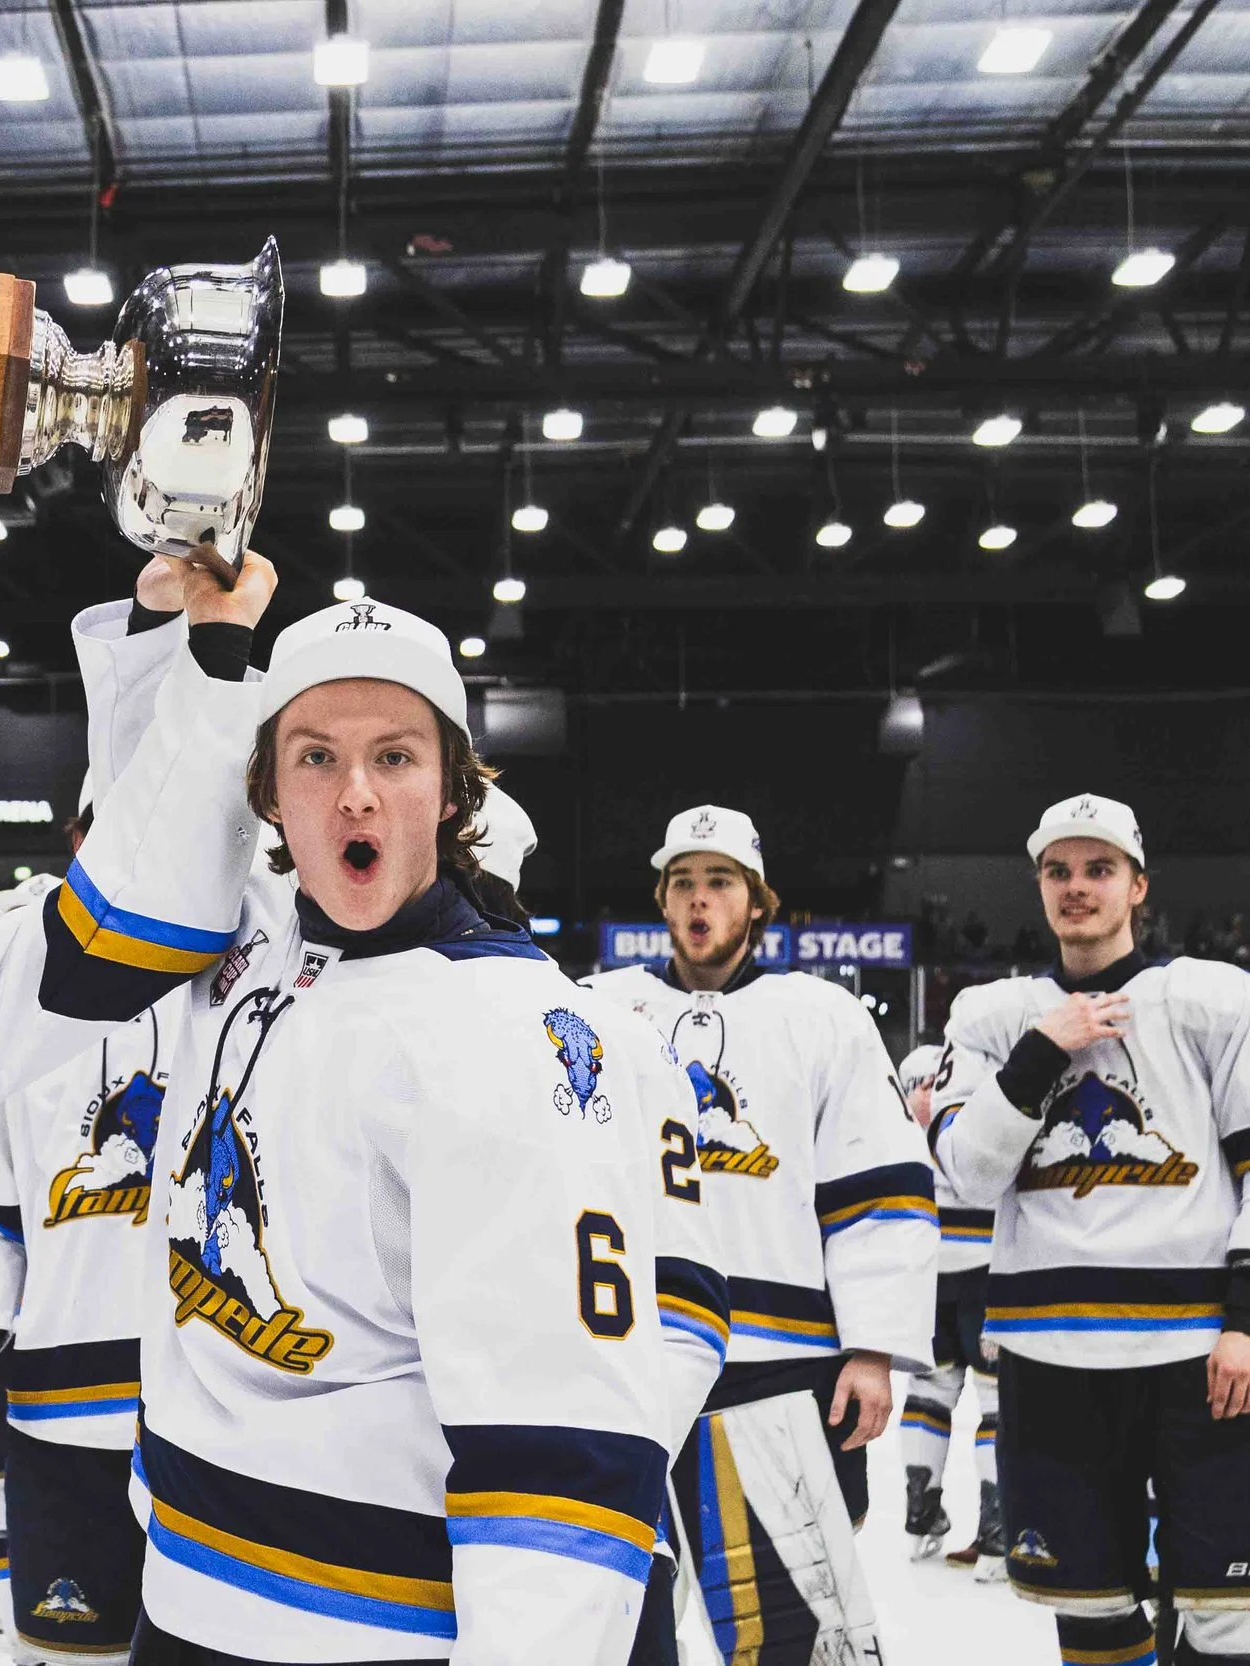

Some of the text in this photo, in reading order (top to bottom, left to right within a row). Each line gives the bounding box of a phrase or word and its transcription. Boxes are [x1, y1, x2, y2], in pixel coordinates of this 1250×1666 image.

[798, 931, 904, 960] STAGE
[236, 1106, 269, 1227] FALLS
[660, 1117, 701, 1205] 2
[169, 1249, 334, 1376] mpede
[575, 1208, 636, 1341] 6
